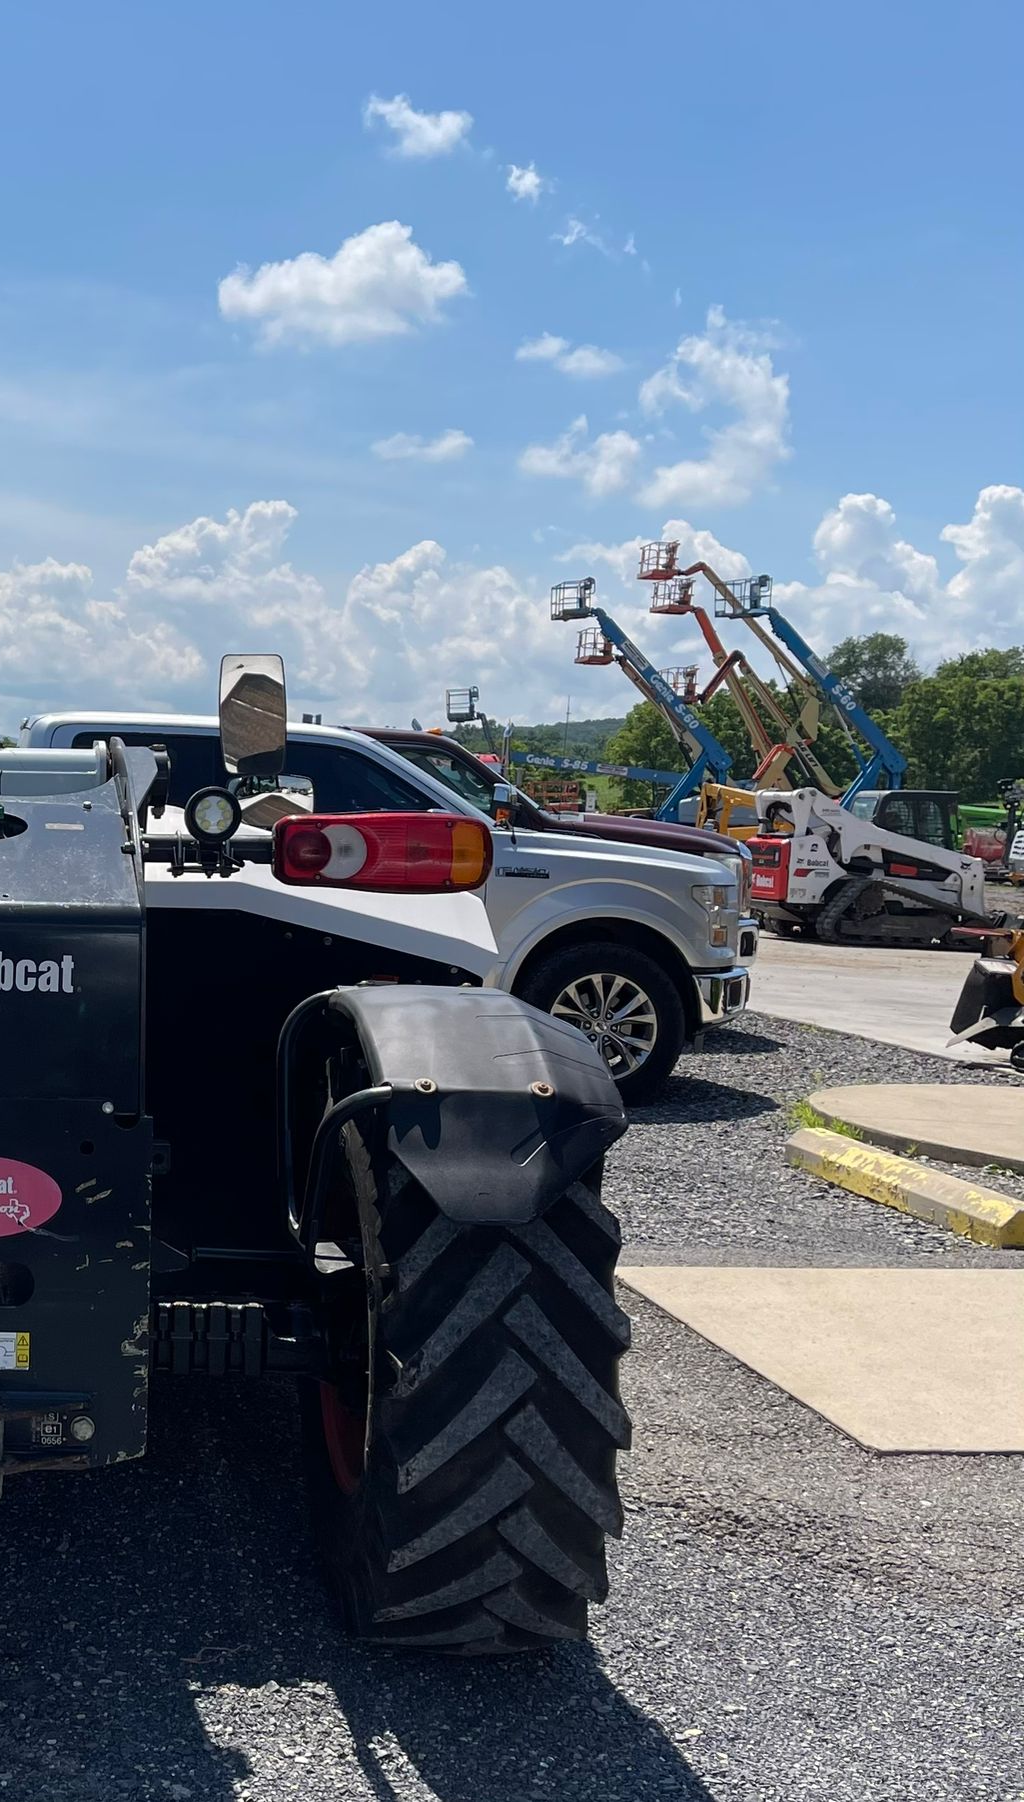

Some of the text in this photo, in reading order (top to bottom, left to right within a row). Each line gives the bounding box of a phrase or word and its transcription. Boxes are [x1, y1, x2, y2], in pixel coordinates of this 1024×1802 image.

[650, 674, 700, 730] Genie S-60
[831, 684, 857, 711] S-60
[526, 754, 556, 767] Genie
[561, 758, 589, 771] S-85
[807, 859, 829, 867] Bobcat
[756, 872, 774, 888] Bobcat
